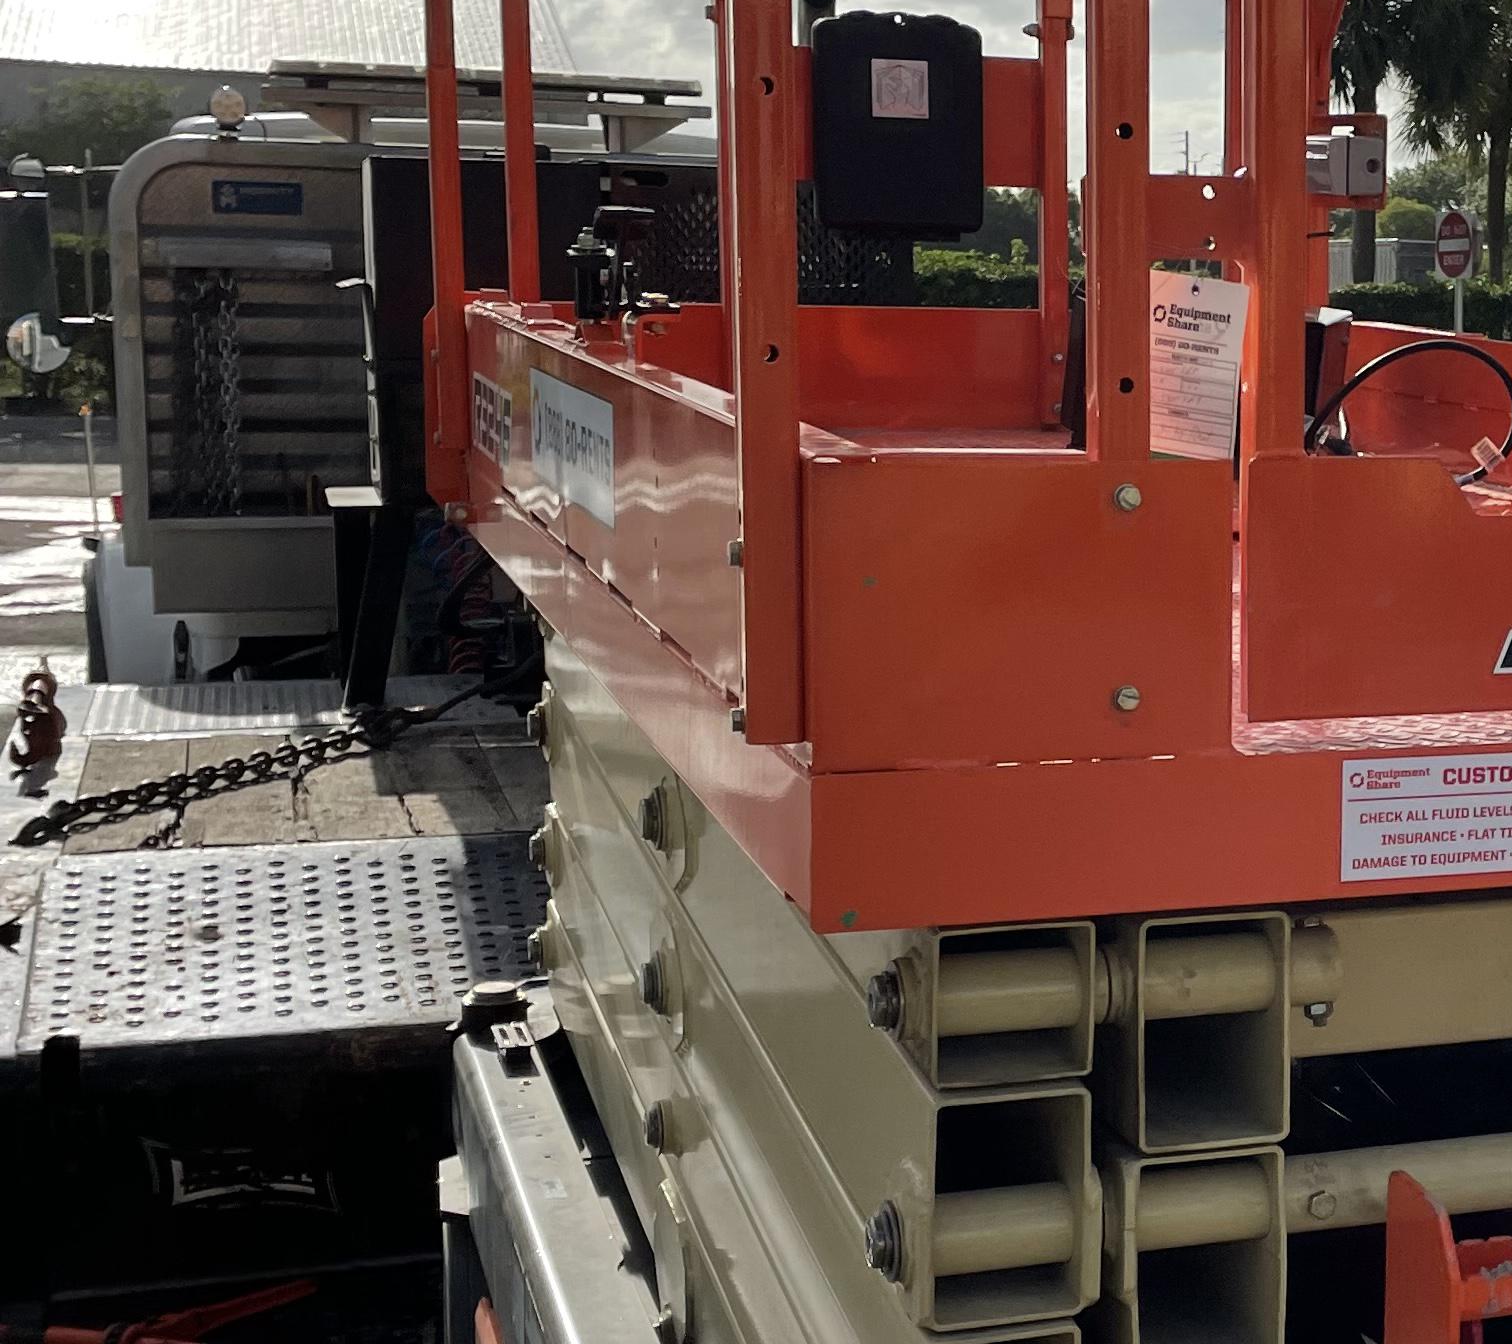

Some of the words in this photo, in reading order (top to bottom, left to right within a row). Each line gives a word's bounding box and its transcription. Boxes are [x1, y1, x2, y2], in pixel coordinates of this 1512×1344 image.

[1169, 304, 1231, 324] Equipment
[1167, 316, 1200, 331] Share
[1366, 768, 1430, 781] Equipment
[1366, 779, 1401, 790] Share
[1360, 809, 1402, 824] CHECK
[1406, 808, 1429, 822] ALL
[1432, 806, 1469, 820] FLUID
[1381, 830, 1456, 846] INSURANCE
[1468, 828, 1496, 841] FLAT
[1352, 855, 1407, 870] DAMAGE
[1412, 854, 1427, 866] TO
[1430, 850, 1506, 865] EQUIPMENT
